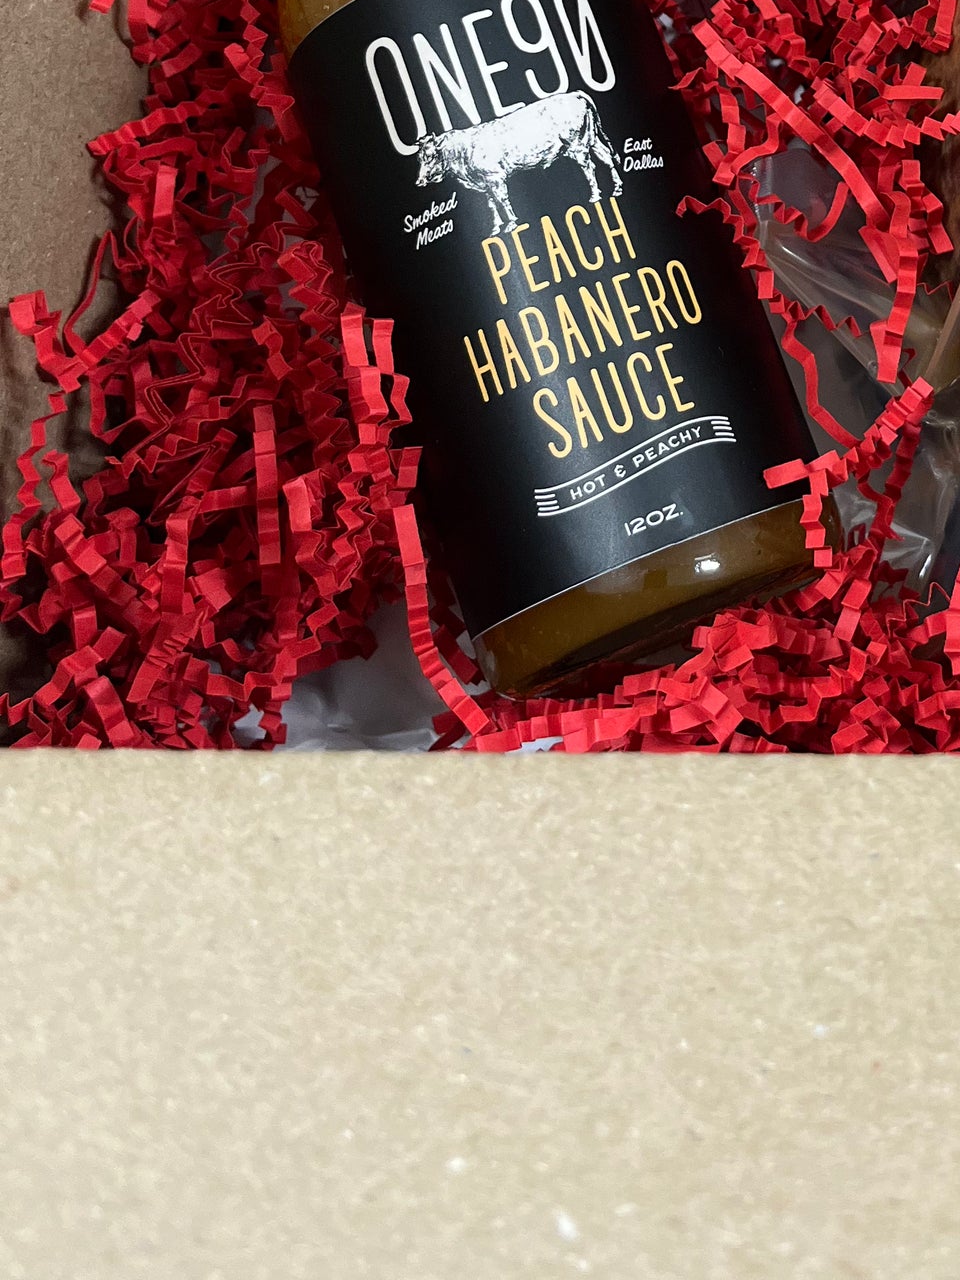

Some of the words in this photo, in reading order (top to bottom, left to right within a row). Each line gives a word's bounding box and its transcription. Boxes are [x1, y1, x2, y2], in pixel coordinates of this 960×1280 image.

[623, 137, 653, 153] East
[623, 154, 664, 173] Dallas
[403, 191, 458, 233] Smoked
[416, 219, 454, 250] Meats
[481, 196, 637, 305] PEACH
[463, 259, 702, 403] HABANERO
[532, 342, 695, 459] SAUCE
[569, 474, 606, 501] HOT
[613, 464, 627, 478] &
[632, 425, 702, 468] PEACHY
